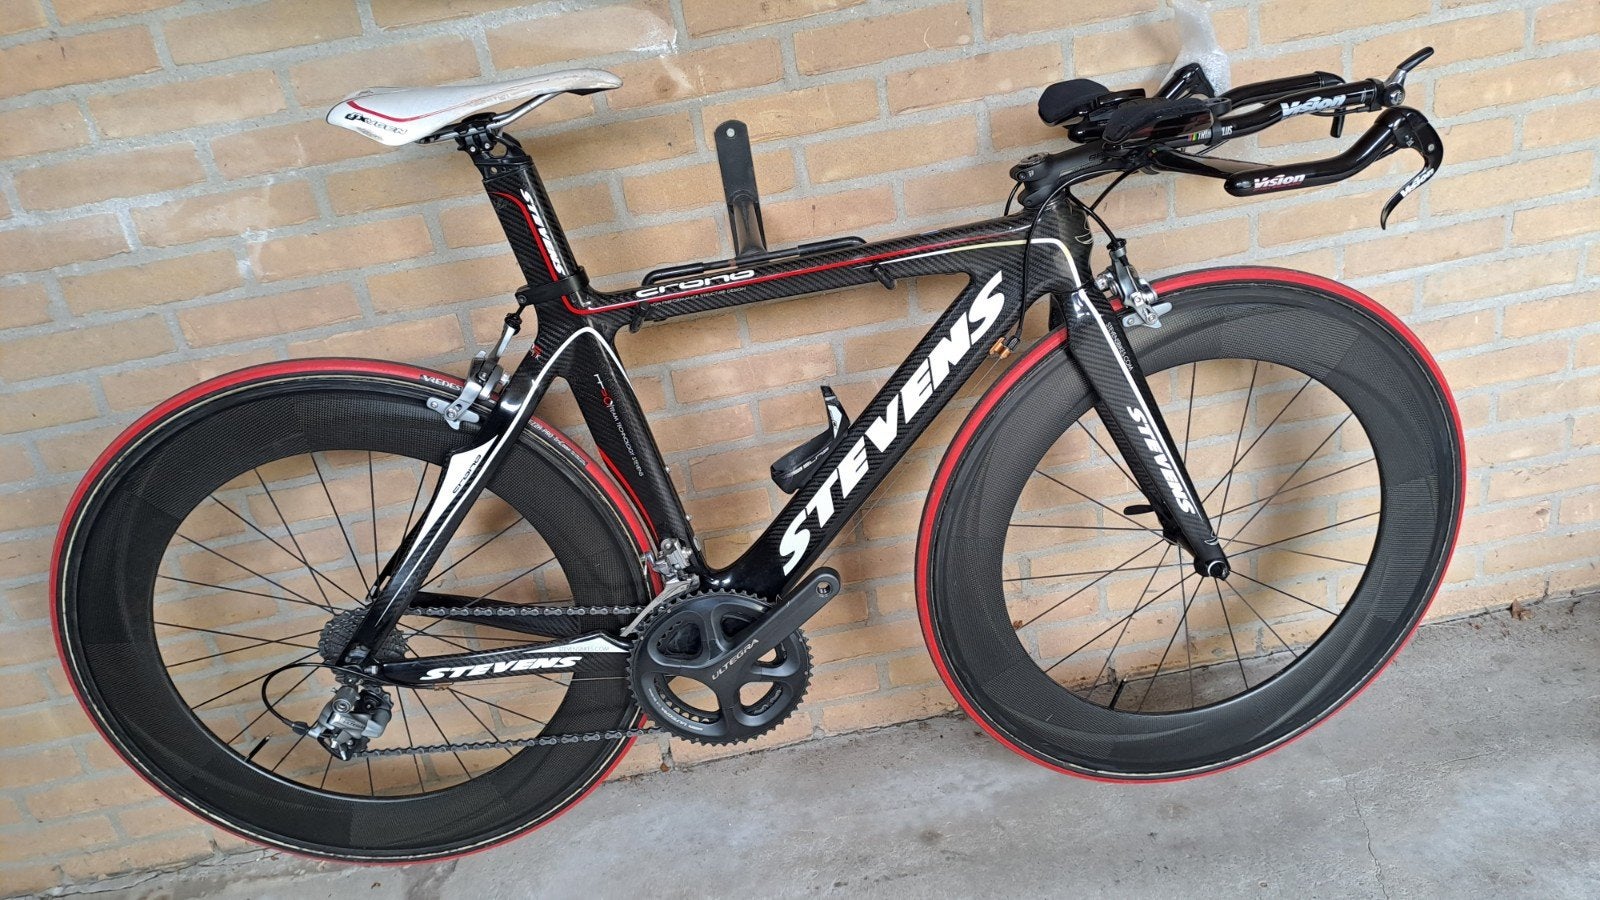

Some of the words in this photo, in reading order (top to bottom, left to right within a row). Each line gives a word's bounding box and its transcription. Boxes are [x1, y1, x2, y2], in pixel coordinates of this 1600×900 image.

[1280, 94, 1346, 117] Vision
[1254, 174, 1306, 189] Vision
[1400, 168, 1434, 197] Vision
[779, 270, 1005, 577] STEVENS
[1126, 405, 1197, 515] STEVENS
[419, 656, 583, 681] STEVENS
[711, 638, 759, 681] ULTEGRA
